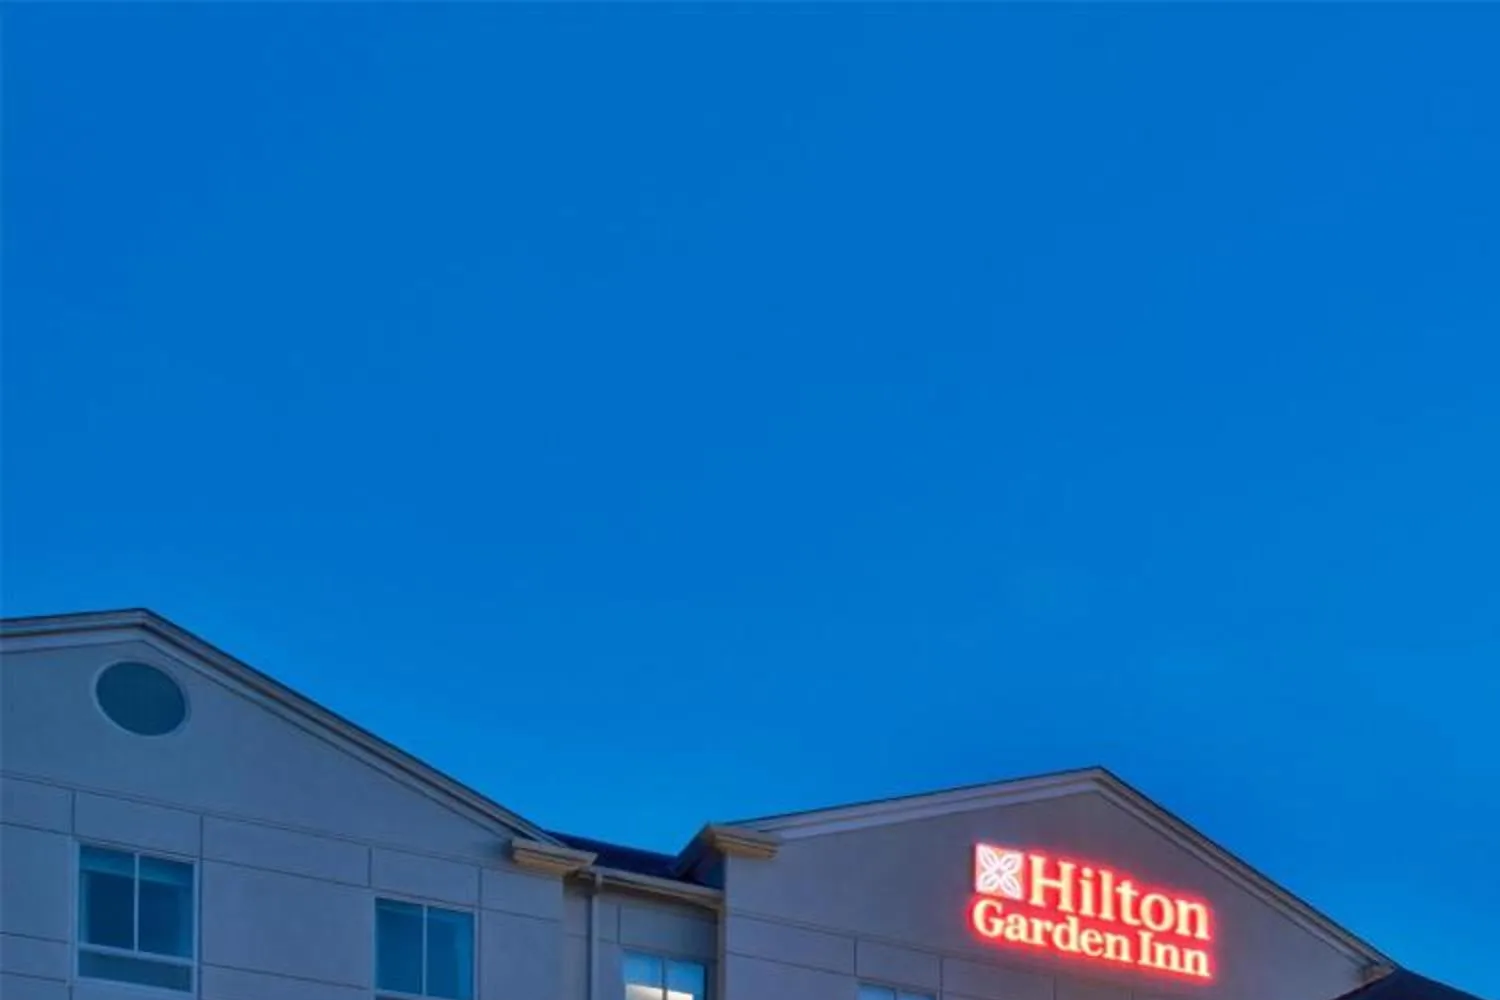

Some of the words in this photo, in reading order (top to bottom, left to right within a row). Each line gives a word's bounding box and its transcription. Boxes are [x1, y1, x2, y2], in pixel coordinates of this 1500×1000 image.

[972, 899, 1133, 963] Garden
[1136, 931, 1211, 977] Inn
[1028, 854, 1211, 940] Hilton
